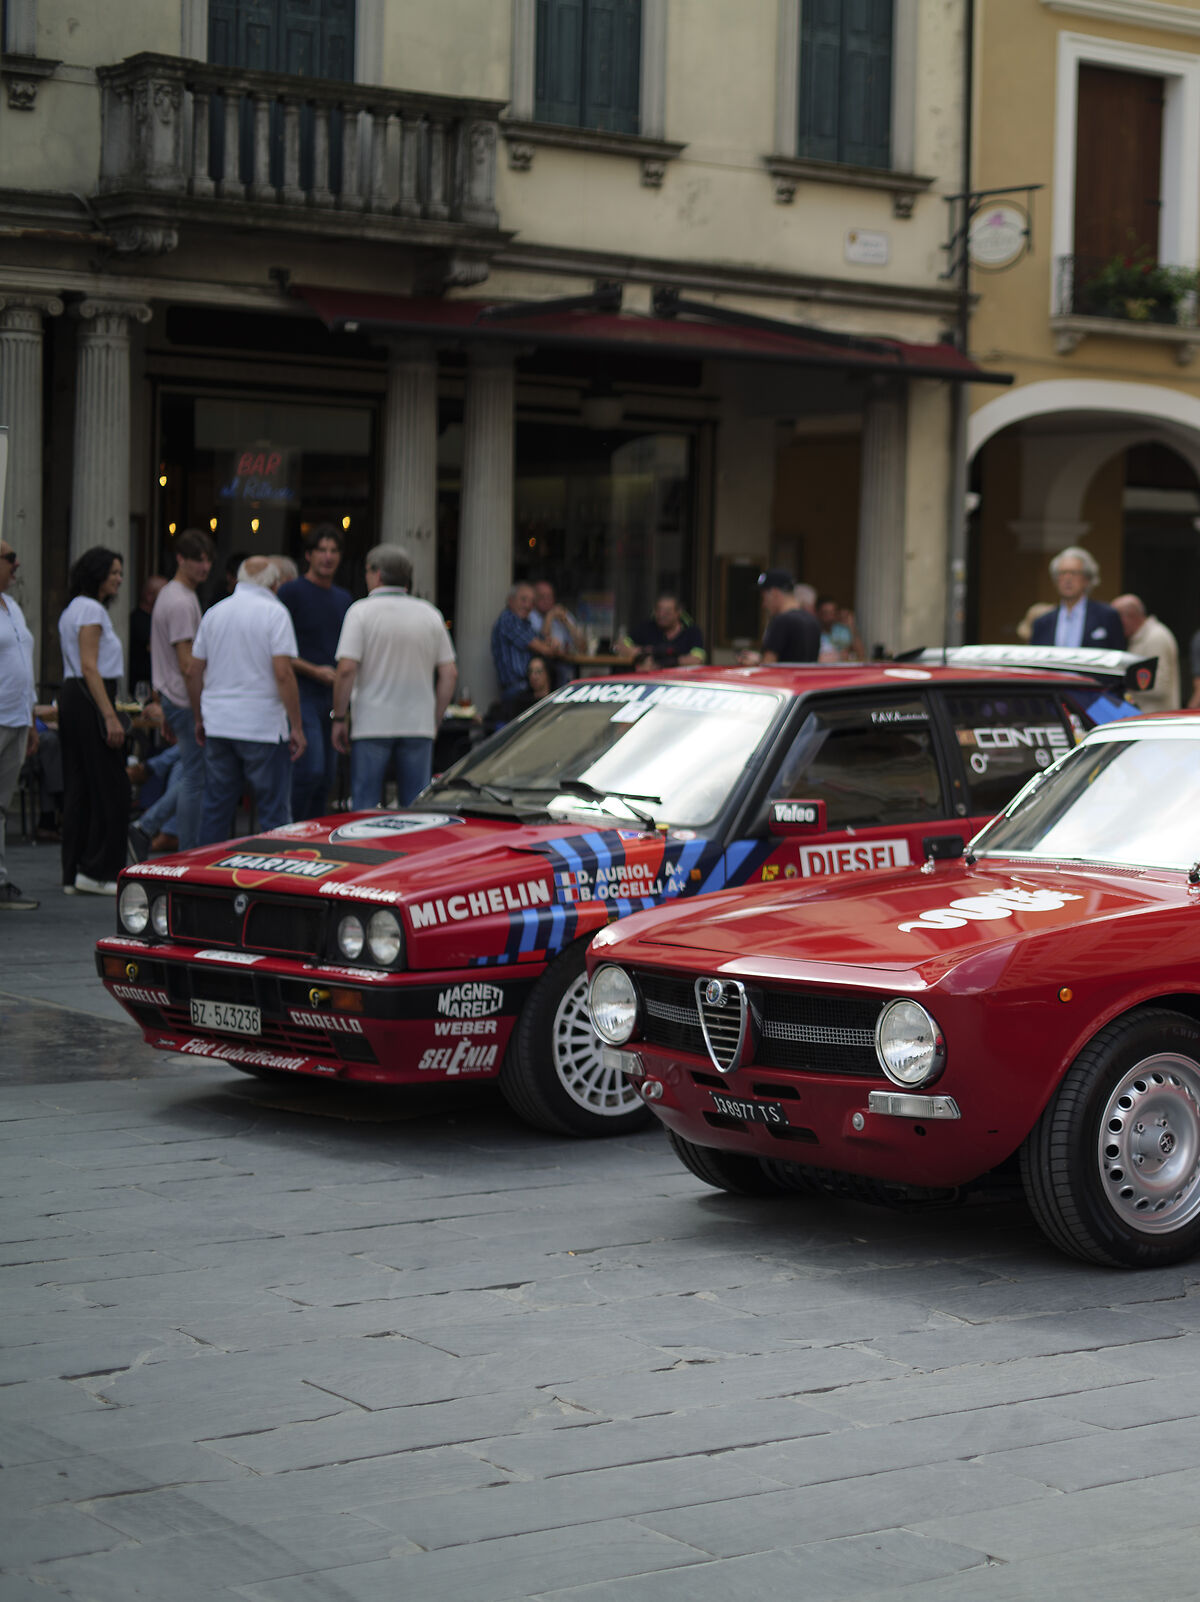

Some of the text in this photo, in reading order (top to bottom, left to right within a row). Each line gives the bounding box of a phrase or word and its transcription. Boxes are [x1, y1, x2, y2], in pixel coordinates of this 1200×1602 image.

[238, 452, 282, 475] BAR
[554, 685, 646, 704] LANCIA
[974, 727, 1070, 748] CONTE
[774, 804, 816, 822] Valeo
[126, 864, 189, 878] MICHELIN
[220, 854, 335, 877] MARTINI
[595, 863, 654, 882] AURIOL
[664, 861, 685, 877] A+
[319, 881, 402, 903] MICHELIN
[597, 879, 663, 899] OCCELLI
[667, 878, 687, 893] A+
[409, 879, 550, 929] MICHELIN
[437, 982, 504, 1003] MAGNETI
[192, 1002, 260, 1032] BZ 543236
[437, 996, 504, 1018] MARELLI
[434, 1020, 498, 1036] WEBER
[180, 1038, 216, 1056] Fiat
[214, 1042, 310, 1071] Lubrificanti
[758, 1105, 780, 1122] TS
